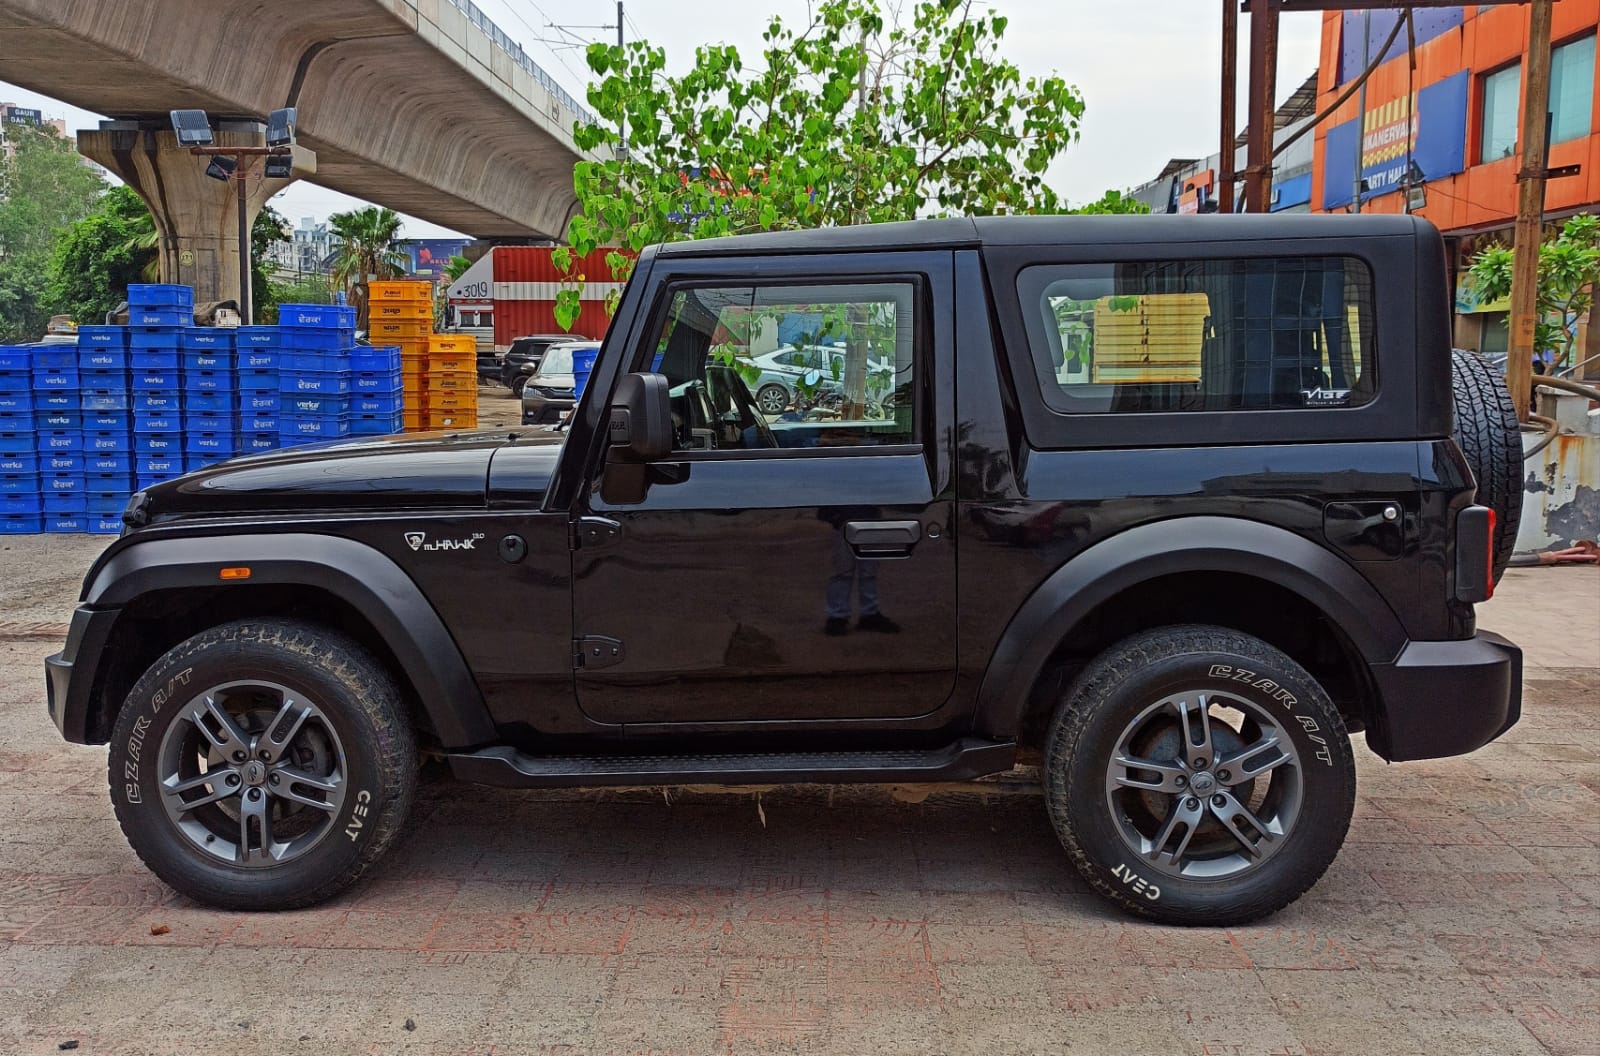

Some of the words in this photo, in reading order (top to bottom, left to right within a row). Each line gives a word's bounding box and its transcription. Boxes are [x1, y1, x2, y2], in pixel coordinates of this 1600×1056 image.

[463, 281, 488, 298] 3019
[91, 356, 113, 364] verka
[297, 401, 320, 409] verka
[298, 422, 320, 430] verka
[1208, 664, 1298, 710] CZAR
[1295, 715, 1333, 767] A/T
[125, 715, 152, 804] CZAR
[151, 667, 193, 714] A/T
[345, 790, 371, 842] CEAT
[1111, 863, 1160, 900] CEAT
